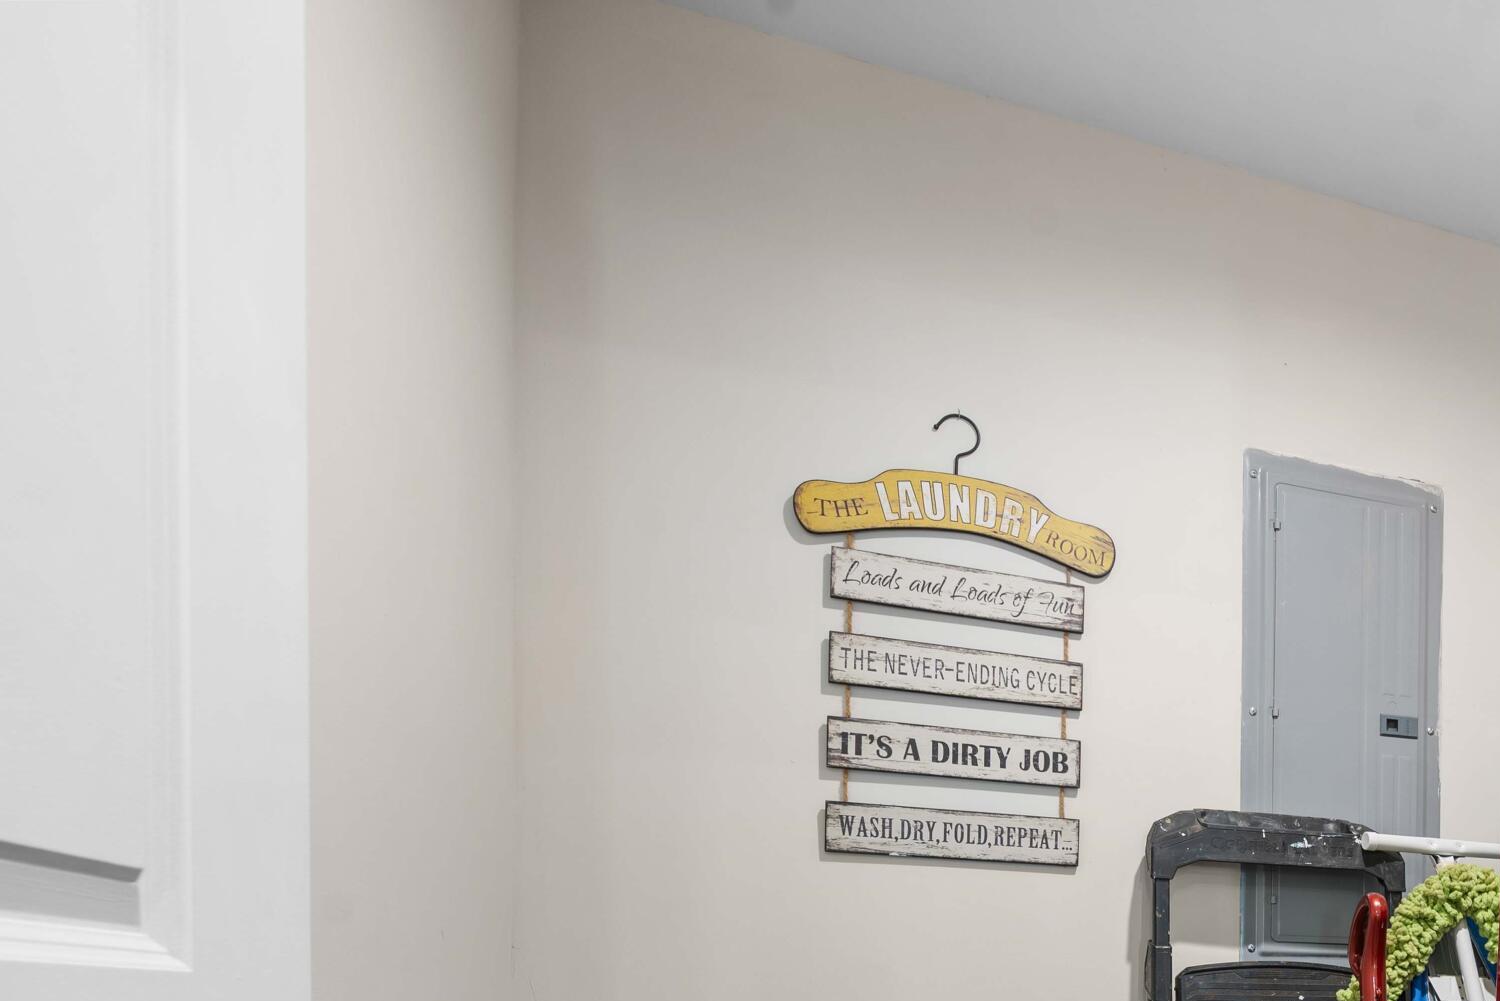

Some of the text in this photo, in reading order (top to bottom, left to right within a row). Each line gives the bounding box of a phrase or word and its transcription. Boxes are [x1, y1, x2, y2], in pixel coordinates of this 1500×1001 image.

[813, 480, 1106, 568] THE LAUNDRY ROOM
[843, 560, 1075, 617] Loads and Loads of Fun
[840, 647, 1078, 697] THE NEVER-ENDING CYCLE
[840, 732, 1069, 774] IT'S A DIRTY JOB
